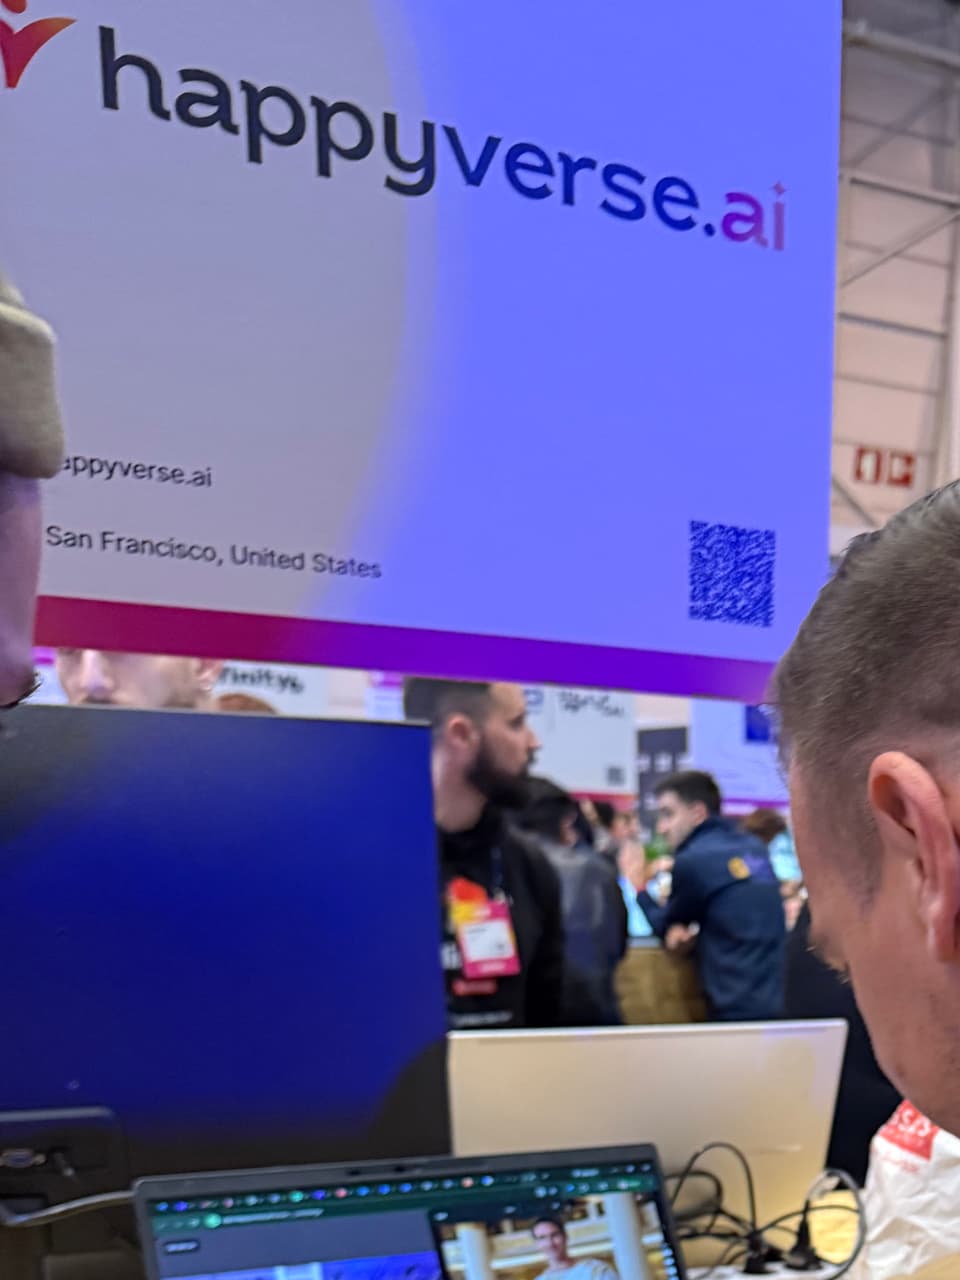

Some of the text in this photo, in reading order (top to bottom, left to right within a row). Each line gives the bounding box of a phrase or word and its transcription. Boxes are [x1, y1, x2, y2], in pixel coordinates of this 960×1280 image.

[98, 25, 787, 252] happyverse.ai
[63, 456, 212, 487] appyverse.ai
[46, 525, 382, 578] San Francisco, United States
